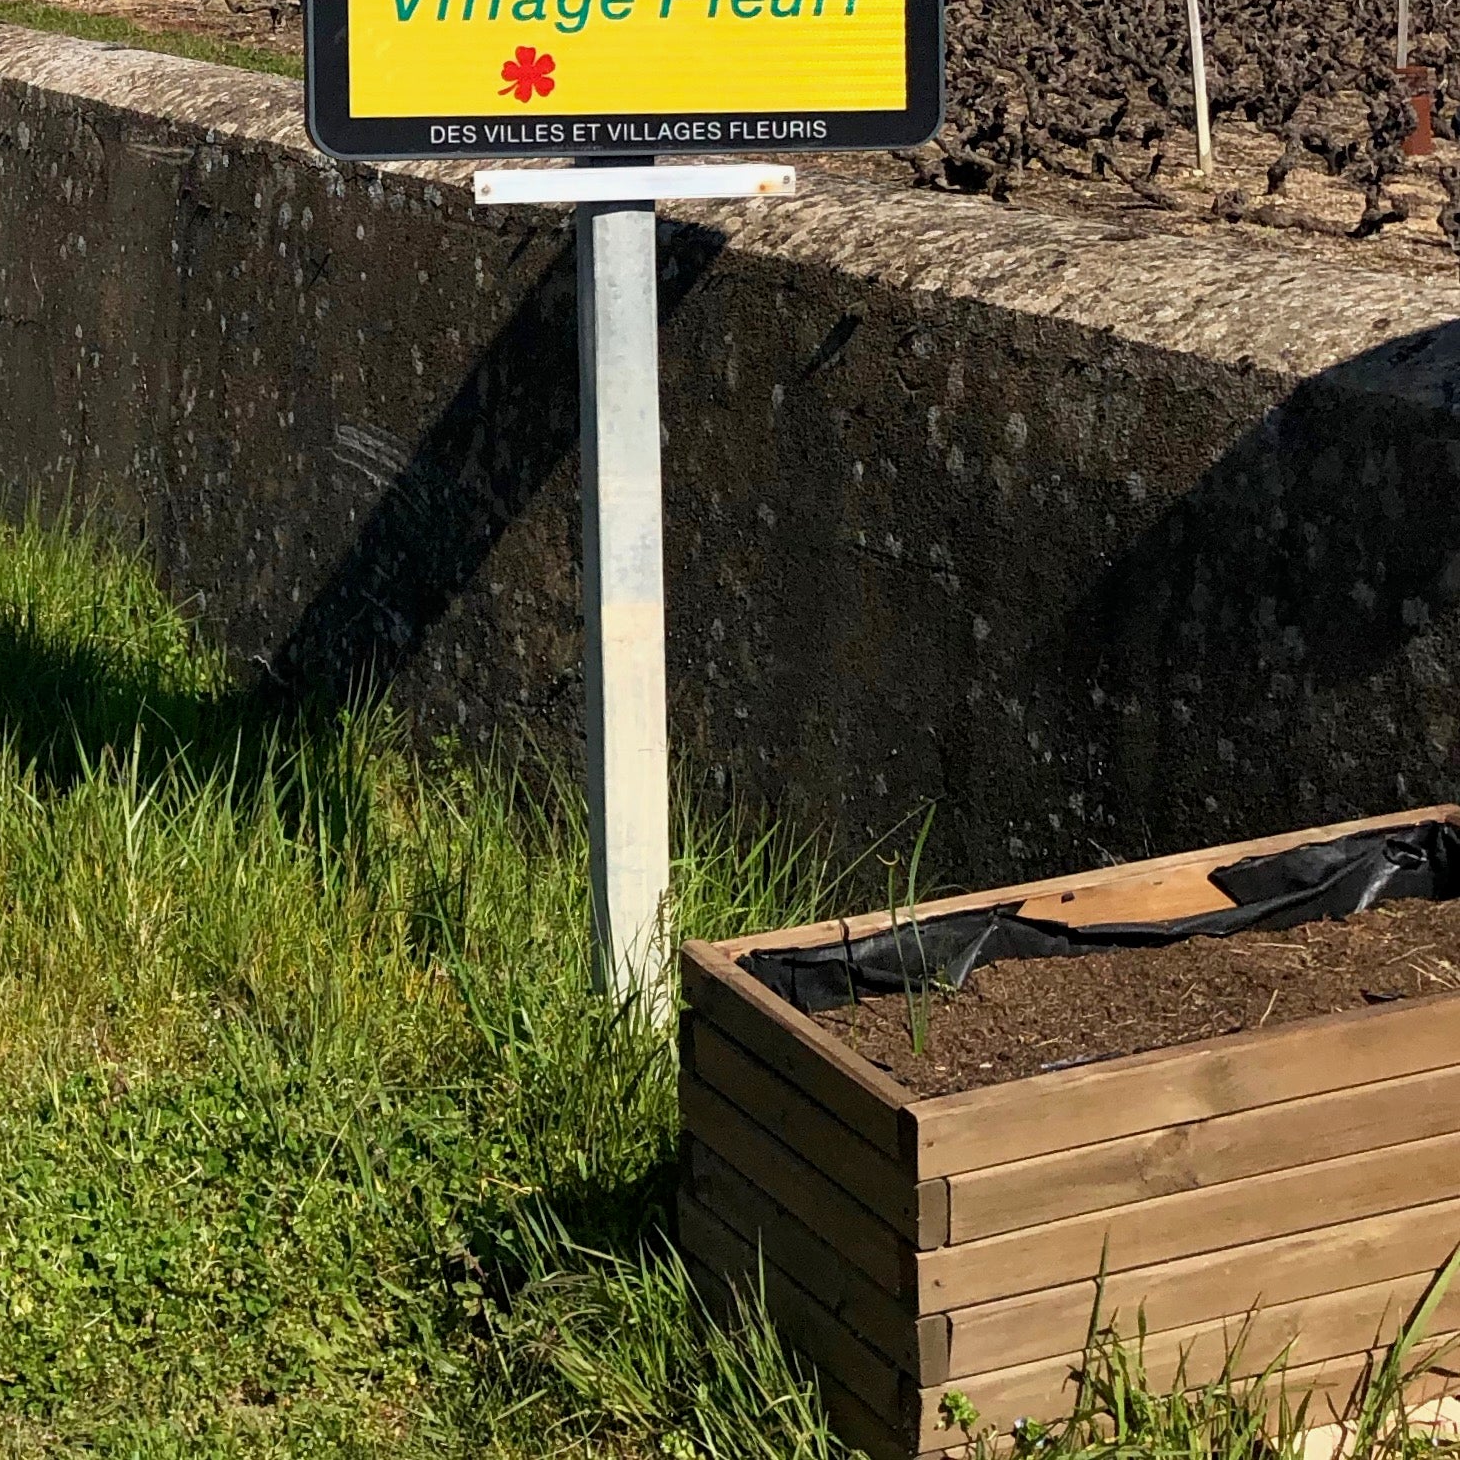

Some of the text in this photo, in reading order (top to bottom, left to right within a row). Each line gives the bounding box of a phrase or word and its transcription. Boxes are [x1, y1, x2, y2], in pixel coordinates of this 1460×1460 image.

[429, 119, 827, 144] DES VILLES ET VILLAGES FLEURIS
